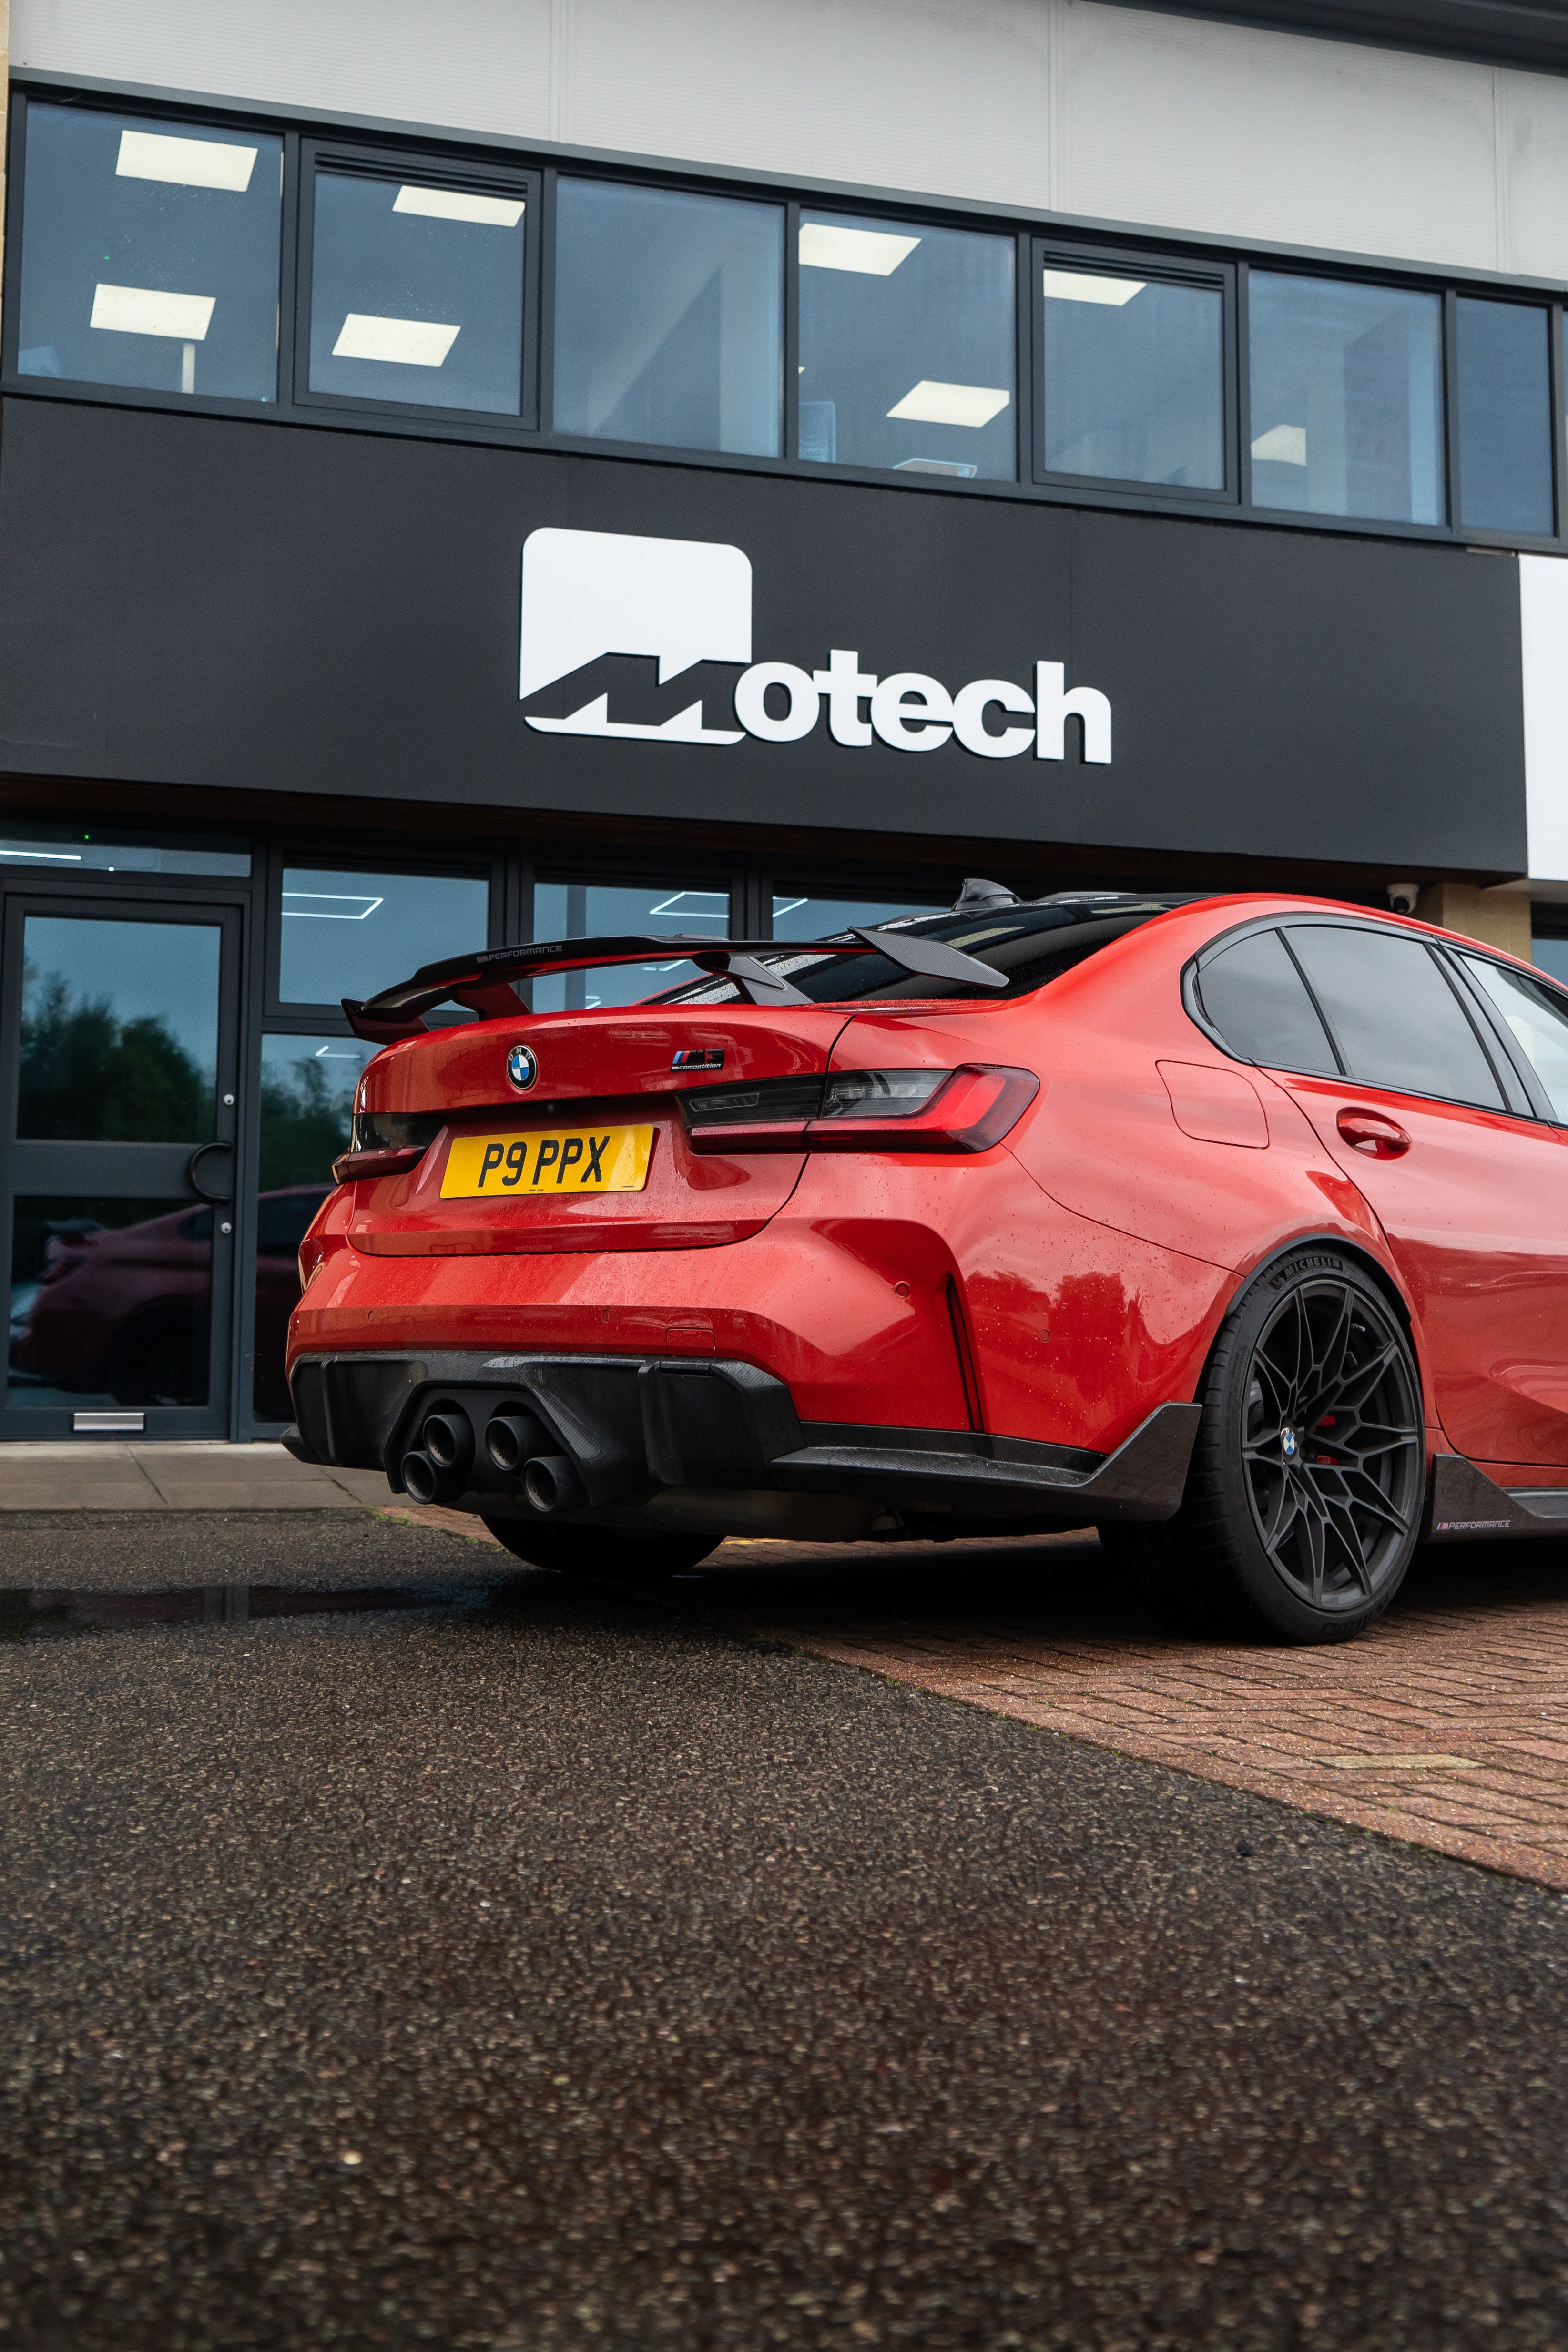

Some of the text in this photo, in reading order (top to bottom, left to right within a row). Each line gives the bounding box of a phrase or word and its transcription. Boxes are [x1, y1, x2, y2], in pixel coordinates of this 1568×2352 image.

[489, 945, 563, 961] PERFORMANCE
[509, 1047, 532, 1061] BMW
[478, 1136, 611, 1188] P9 PPX
[1284, 1257, 1340, 1279] MICHELIN
[1448, 1520, 1511, 1529] PERFORMANCE
